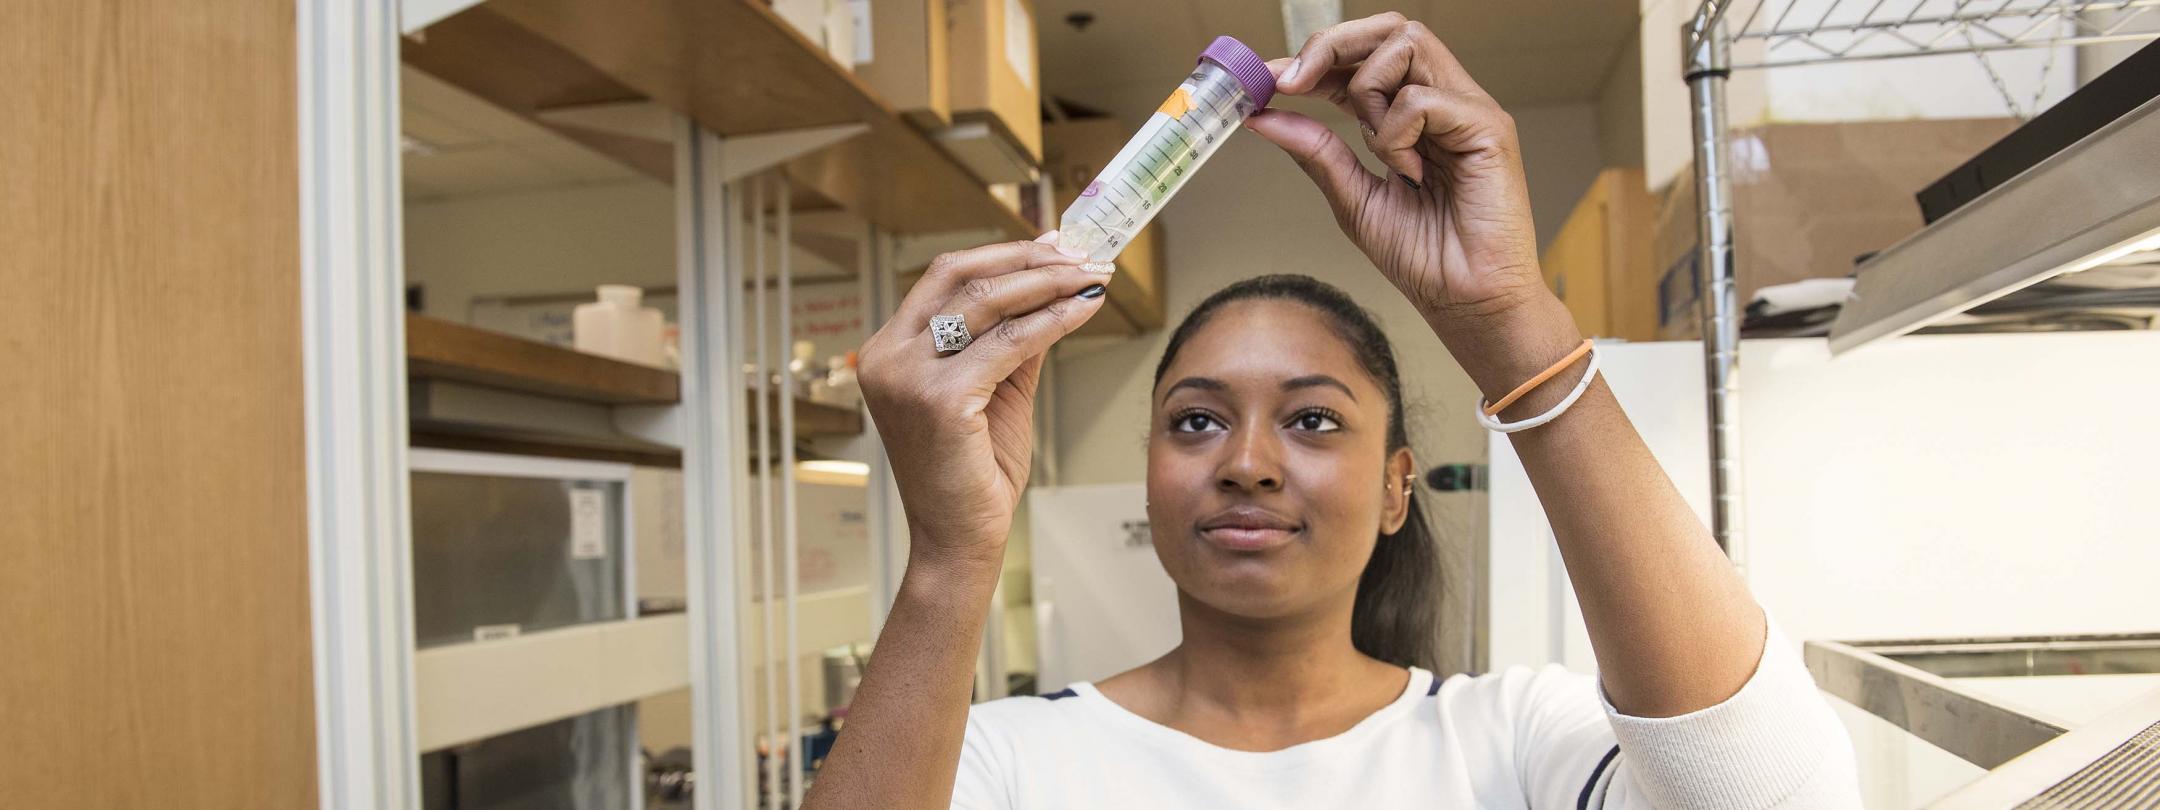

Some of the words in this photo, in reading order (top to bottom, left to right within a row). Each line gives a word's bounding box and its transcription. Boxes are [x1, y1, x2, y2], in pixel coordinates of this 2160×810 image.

[1190, 150, 1199, 160] 30
[1174, 166, 1183, 176] 25
[1158, 183, 1167, 193] 20
[1142, 200, 1151, 210] 15
[1126, 217, 1134, 228] 10
[1107, 235, 1118, 248] 5.0
